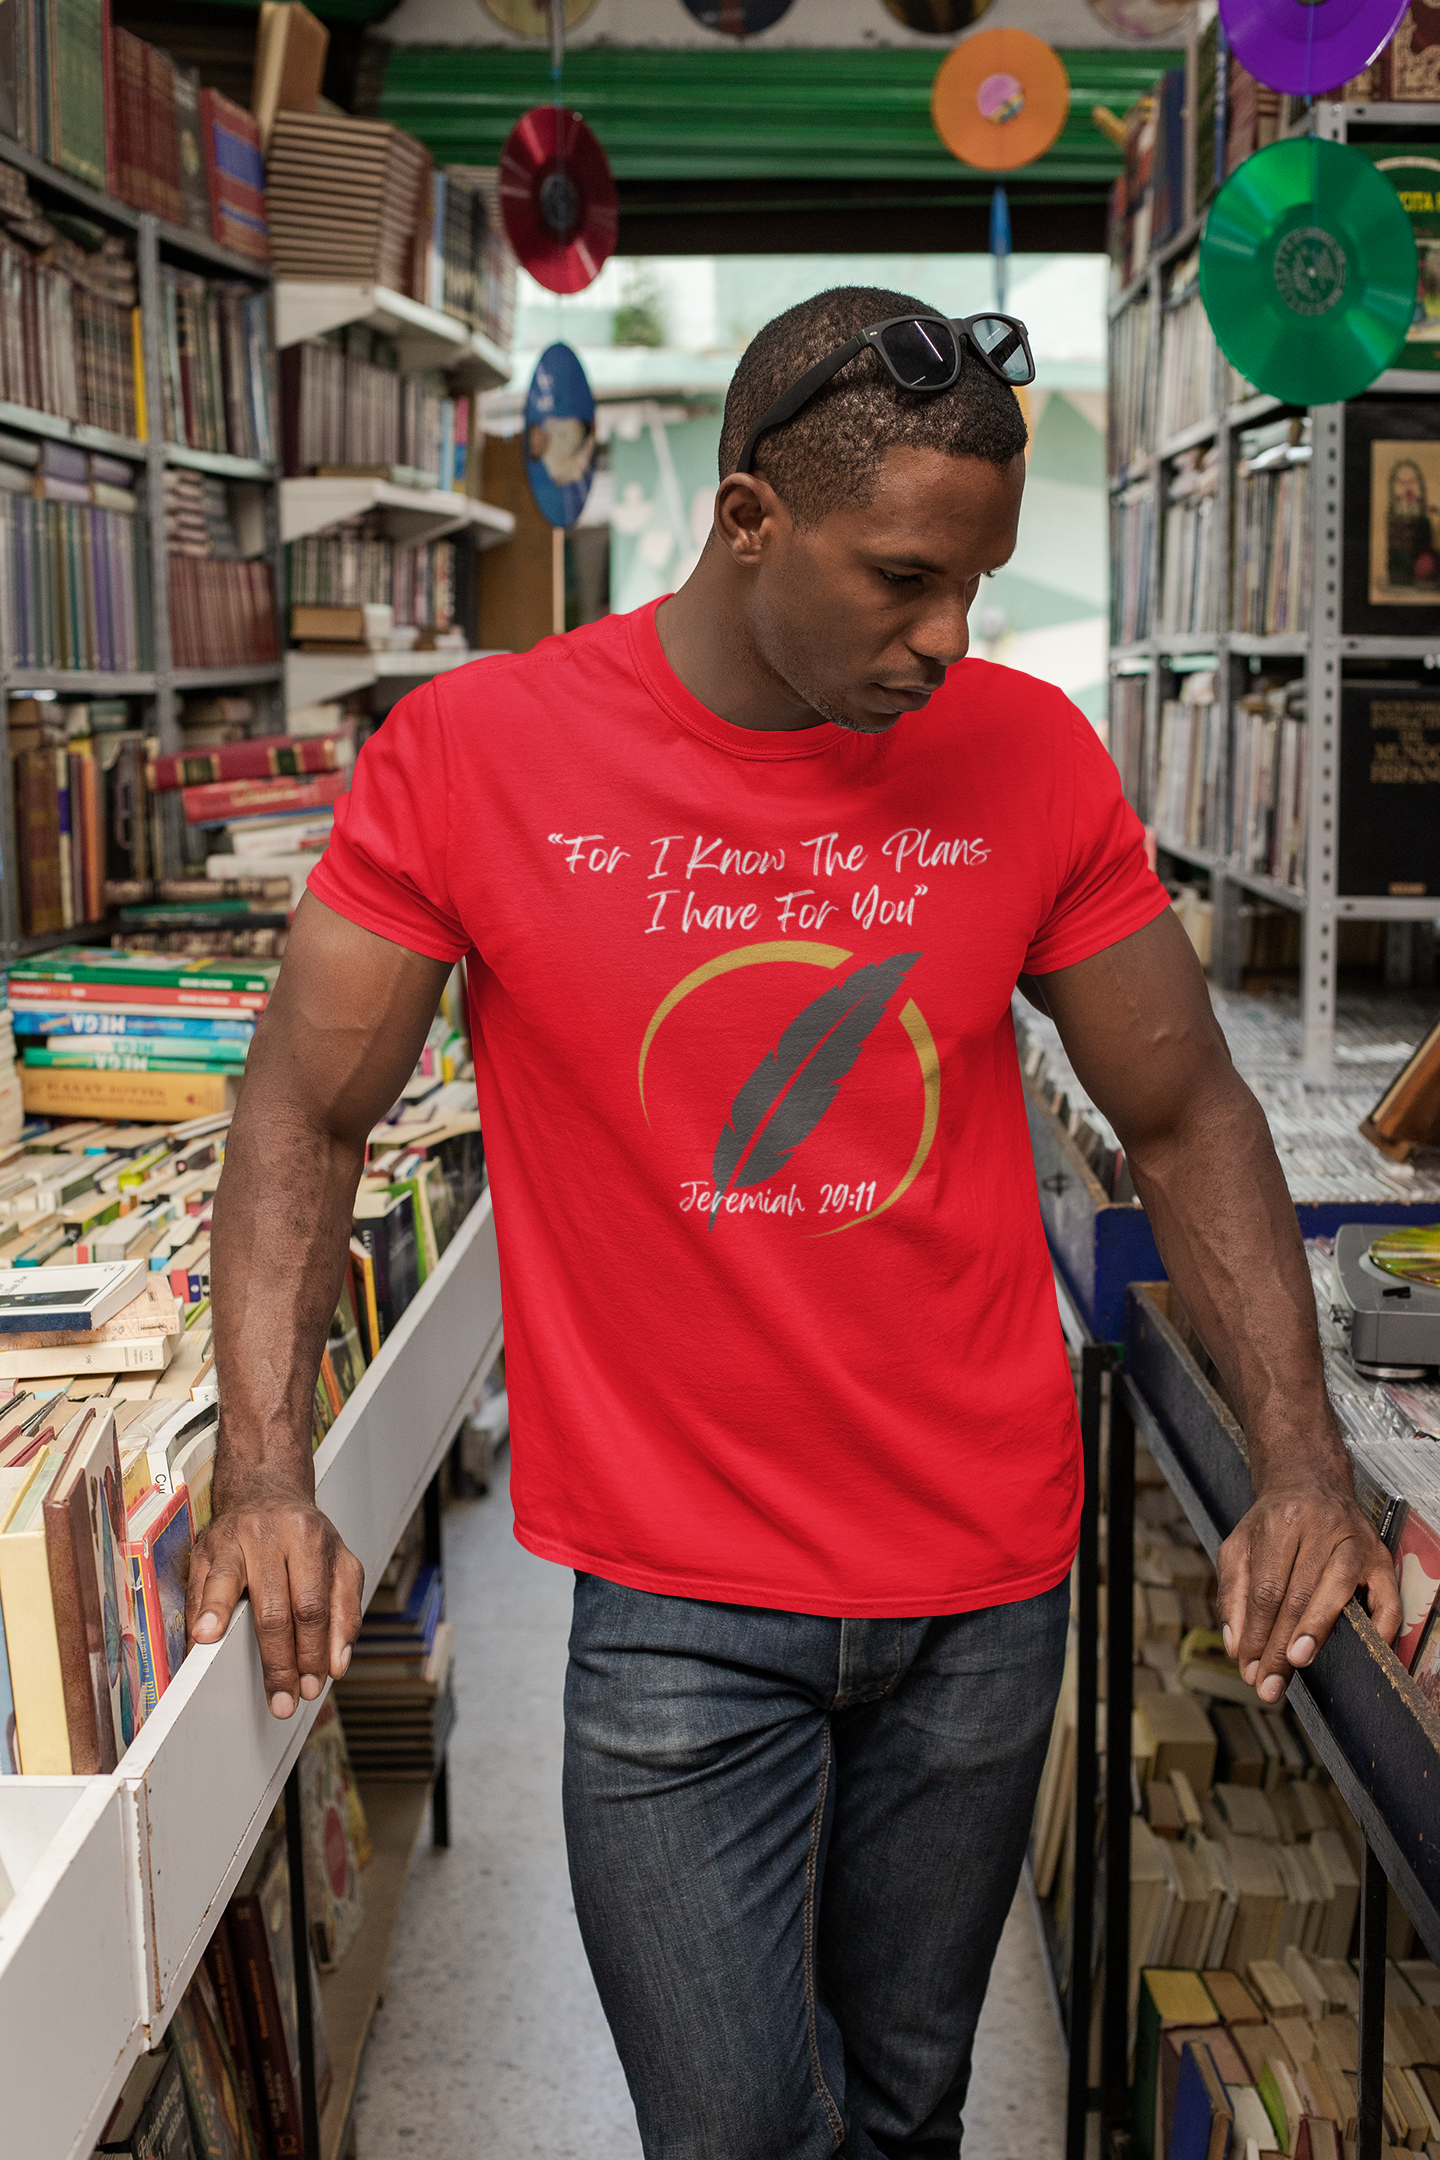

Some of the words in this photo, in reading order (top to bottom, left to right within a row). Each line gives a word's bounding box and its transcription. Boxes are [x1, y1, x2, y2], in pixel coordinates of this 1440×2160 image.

[648, 835, 684, 880] I
[686, 834, 786, 880] Know
[801, 832, 869, 877] The
[882, 828, 992, 873] Plans
[645, 889, 681, 934] I
[682, 889, 762, 934] have
[774, 889, 839, 932] For
[71, 1013, 126, 1034] MEGA
[94, 1053, 149, 1072] MEGA
[679, 1180, 806, 1217] Jeremiah
[818, 1180, 878, 1214] 29:11
